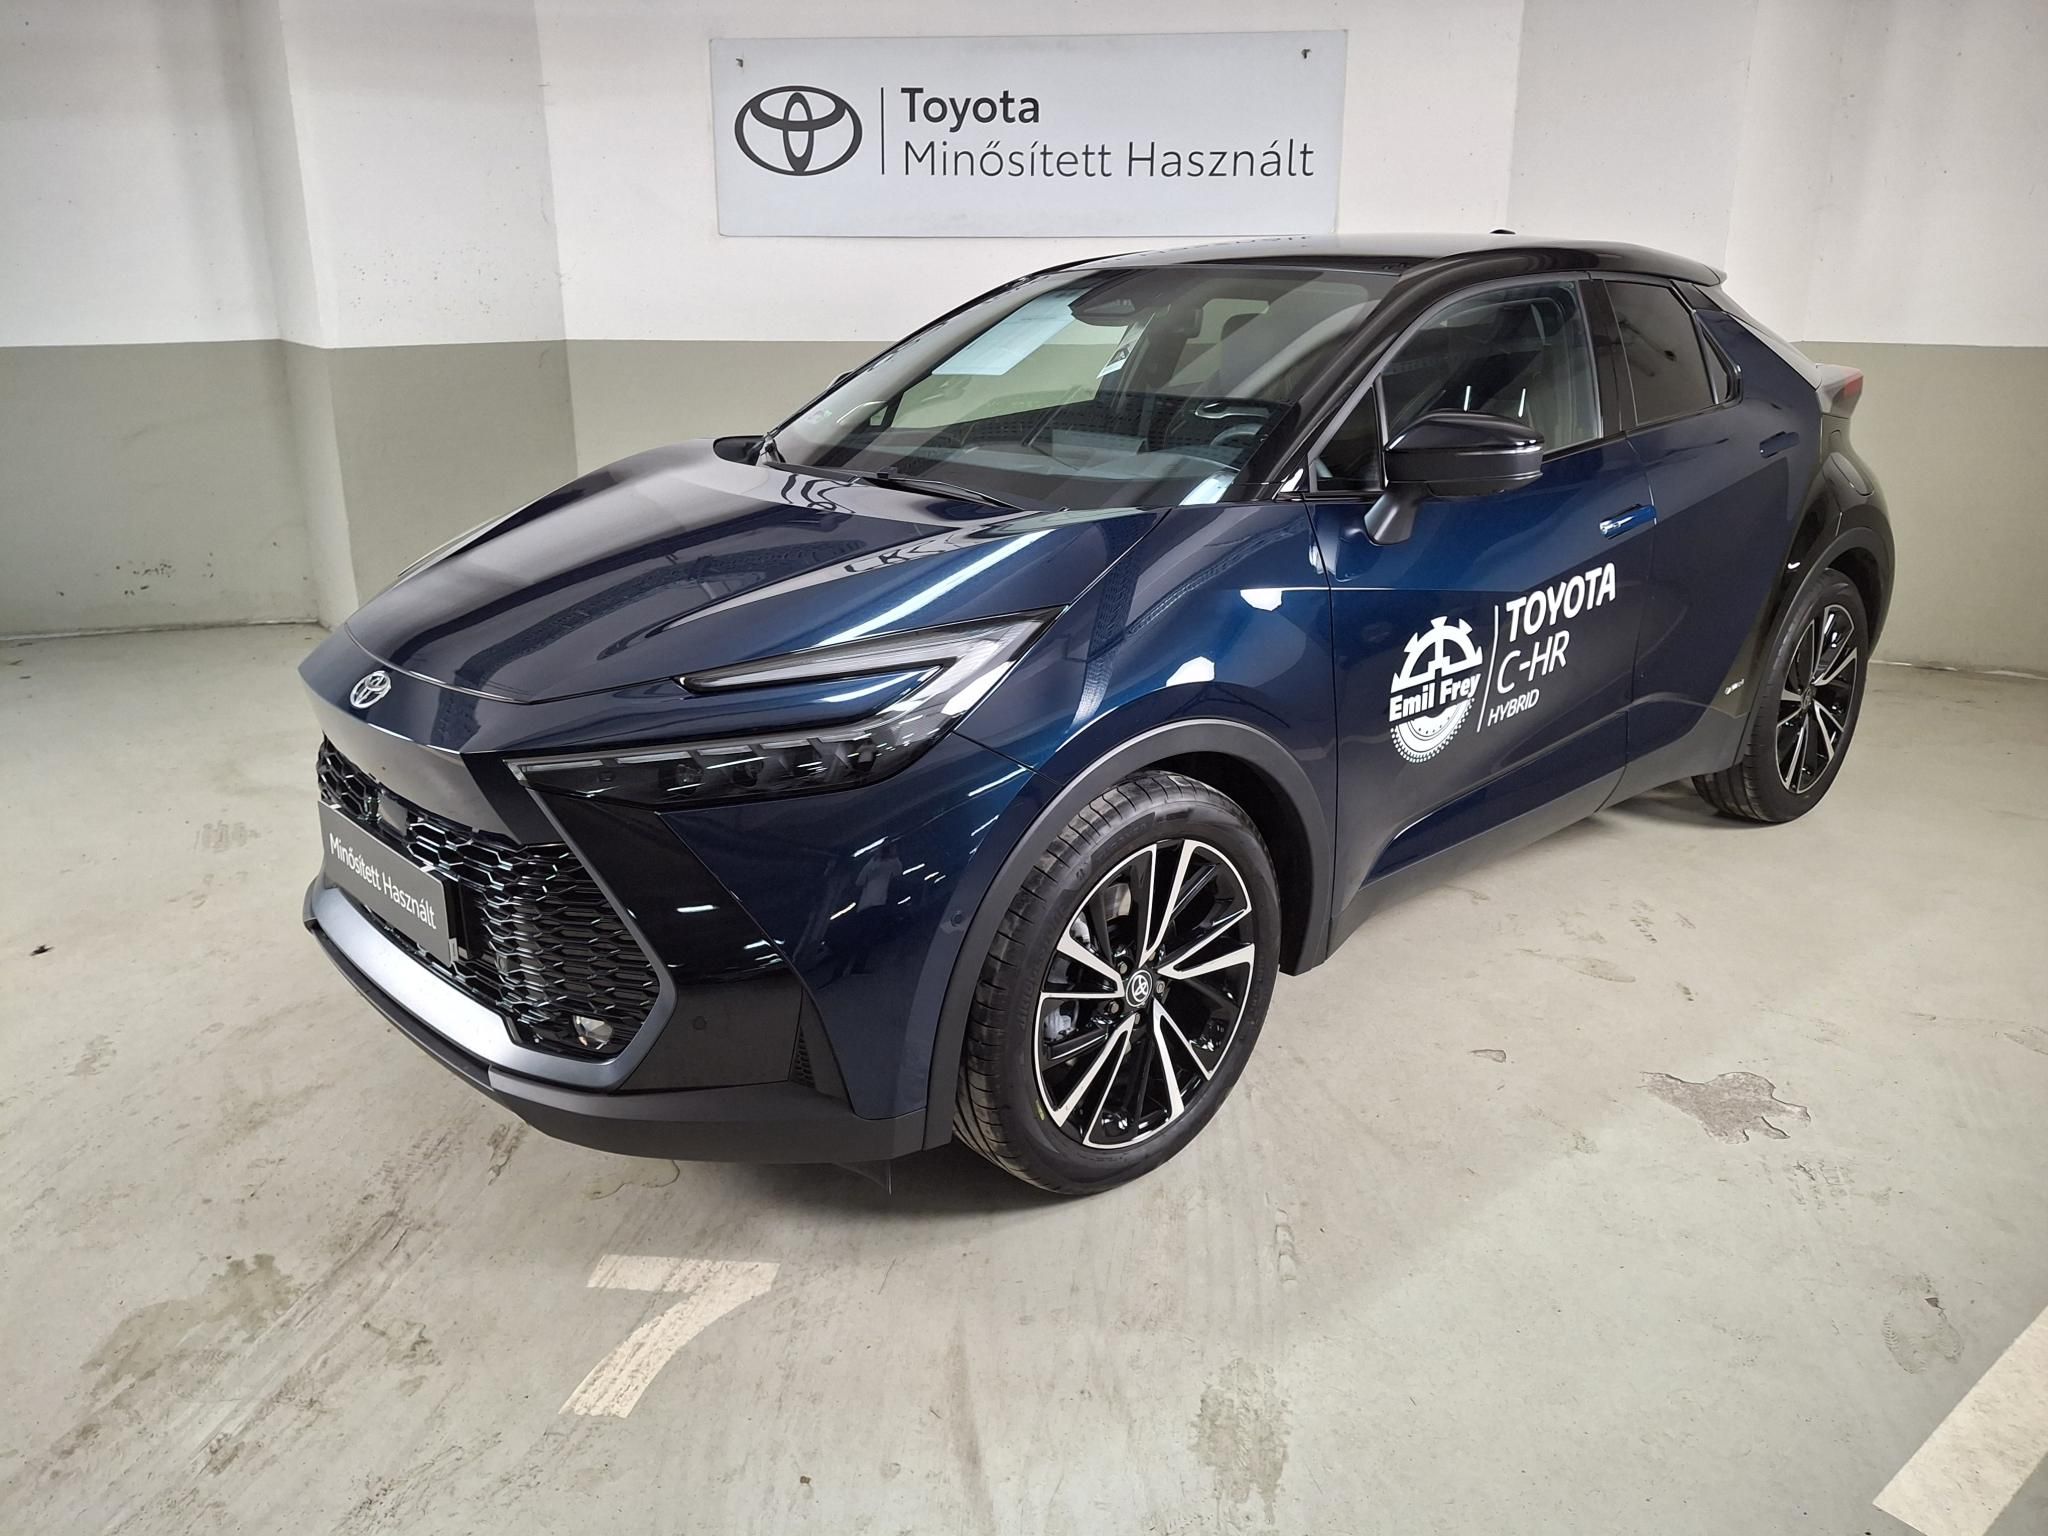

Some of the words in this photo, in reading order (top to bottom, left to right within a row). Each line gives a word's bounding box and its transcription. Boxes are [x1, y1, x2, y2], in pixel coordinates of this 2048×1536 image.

[901, 87, 1040, 132] Toyota
[905, 138, 1112, 178] Minősített
[1128, 138, 1314, 177] Használt
[1506, 562, 1616, 642] TOYOTA
[1497, 630, 1570, 694] C-HR
[1389, 683, 1435, 722] Emil
[1439, 673, 1482, 704] Frey
[1487, 689, 1540, 727] HYBRID
[329, 832, 381, 891] Minősített
[382, 872, 437, 930] Használt
[558, 1254, 780, 1419] 7
